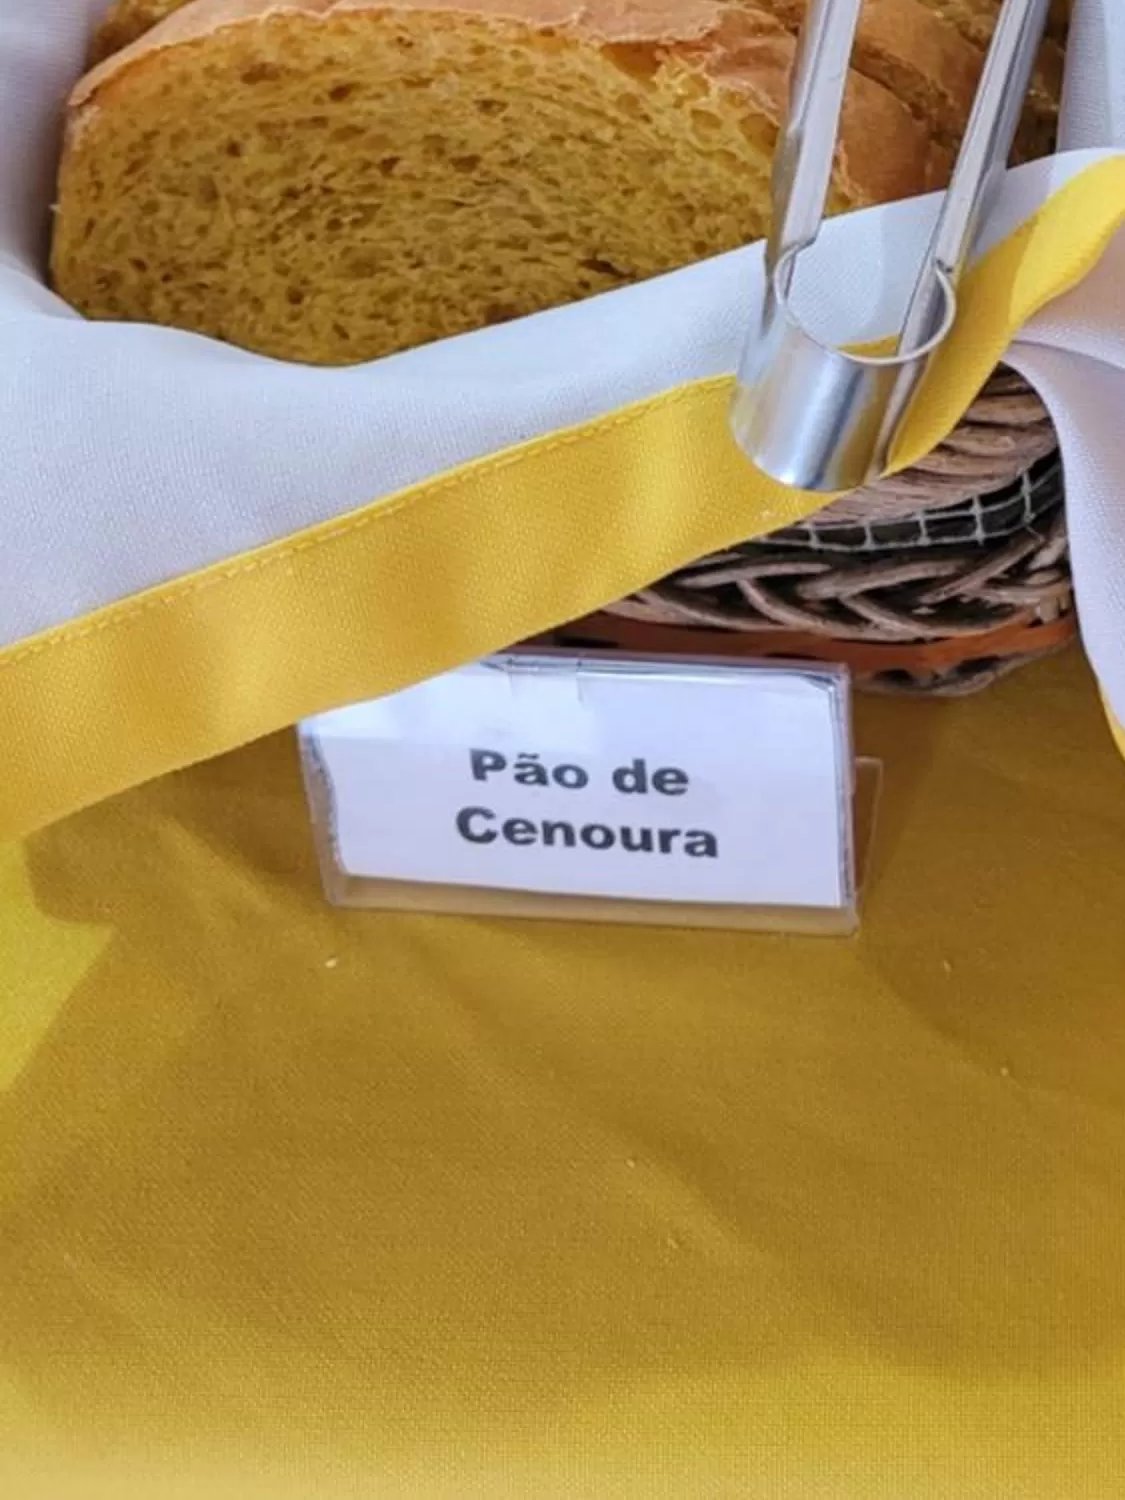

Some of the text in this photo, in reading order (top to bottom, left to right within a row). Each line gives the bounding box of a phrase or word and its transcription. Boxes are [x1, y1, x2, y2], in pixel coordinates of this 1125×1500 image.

[468, 747, 690, 796] Pão de
[455, 806, 719, 858] Cenoura
